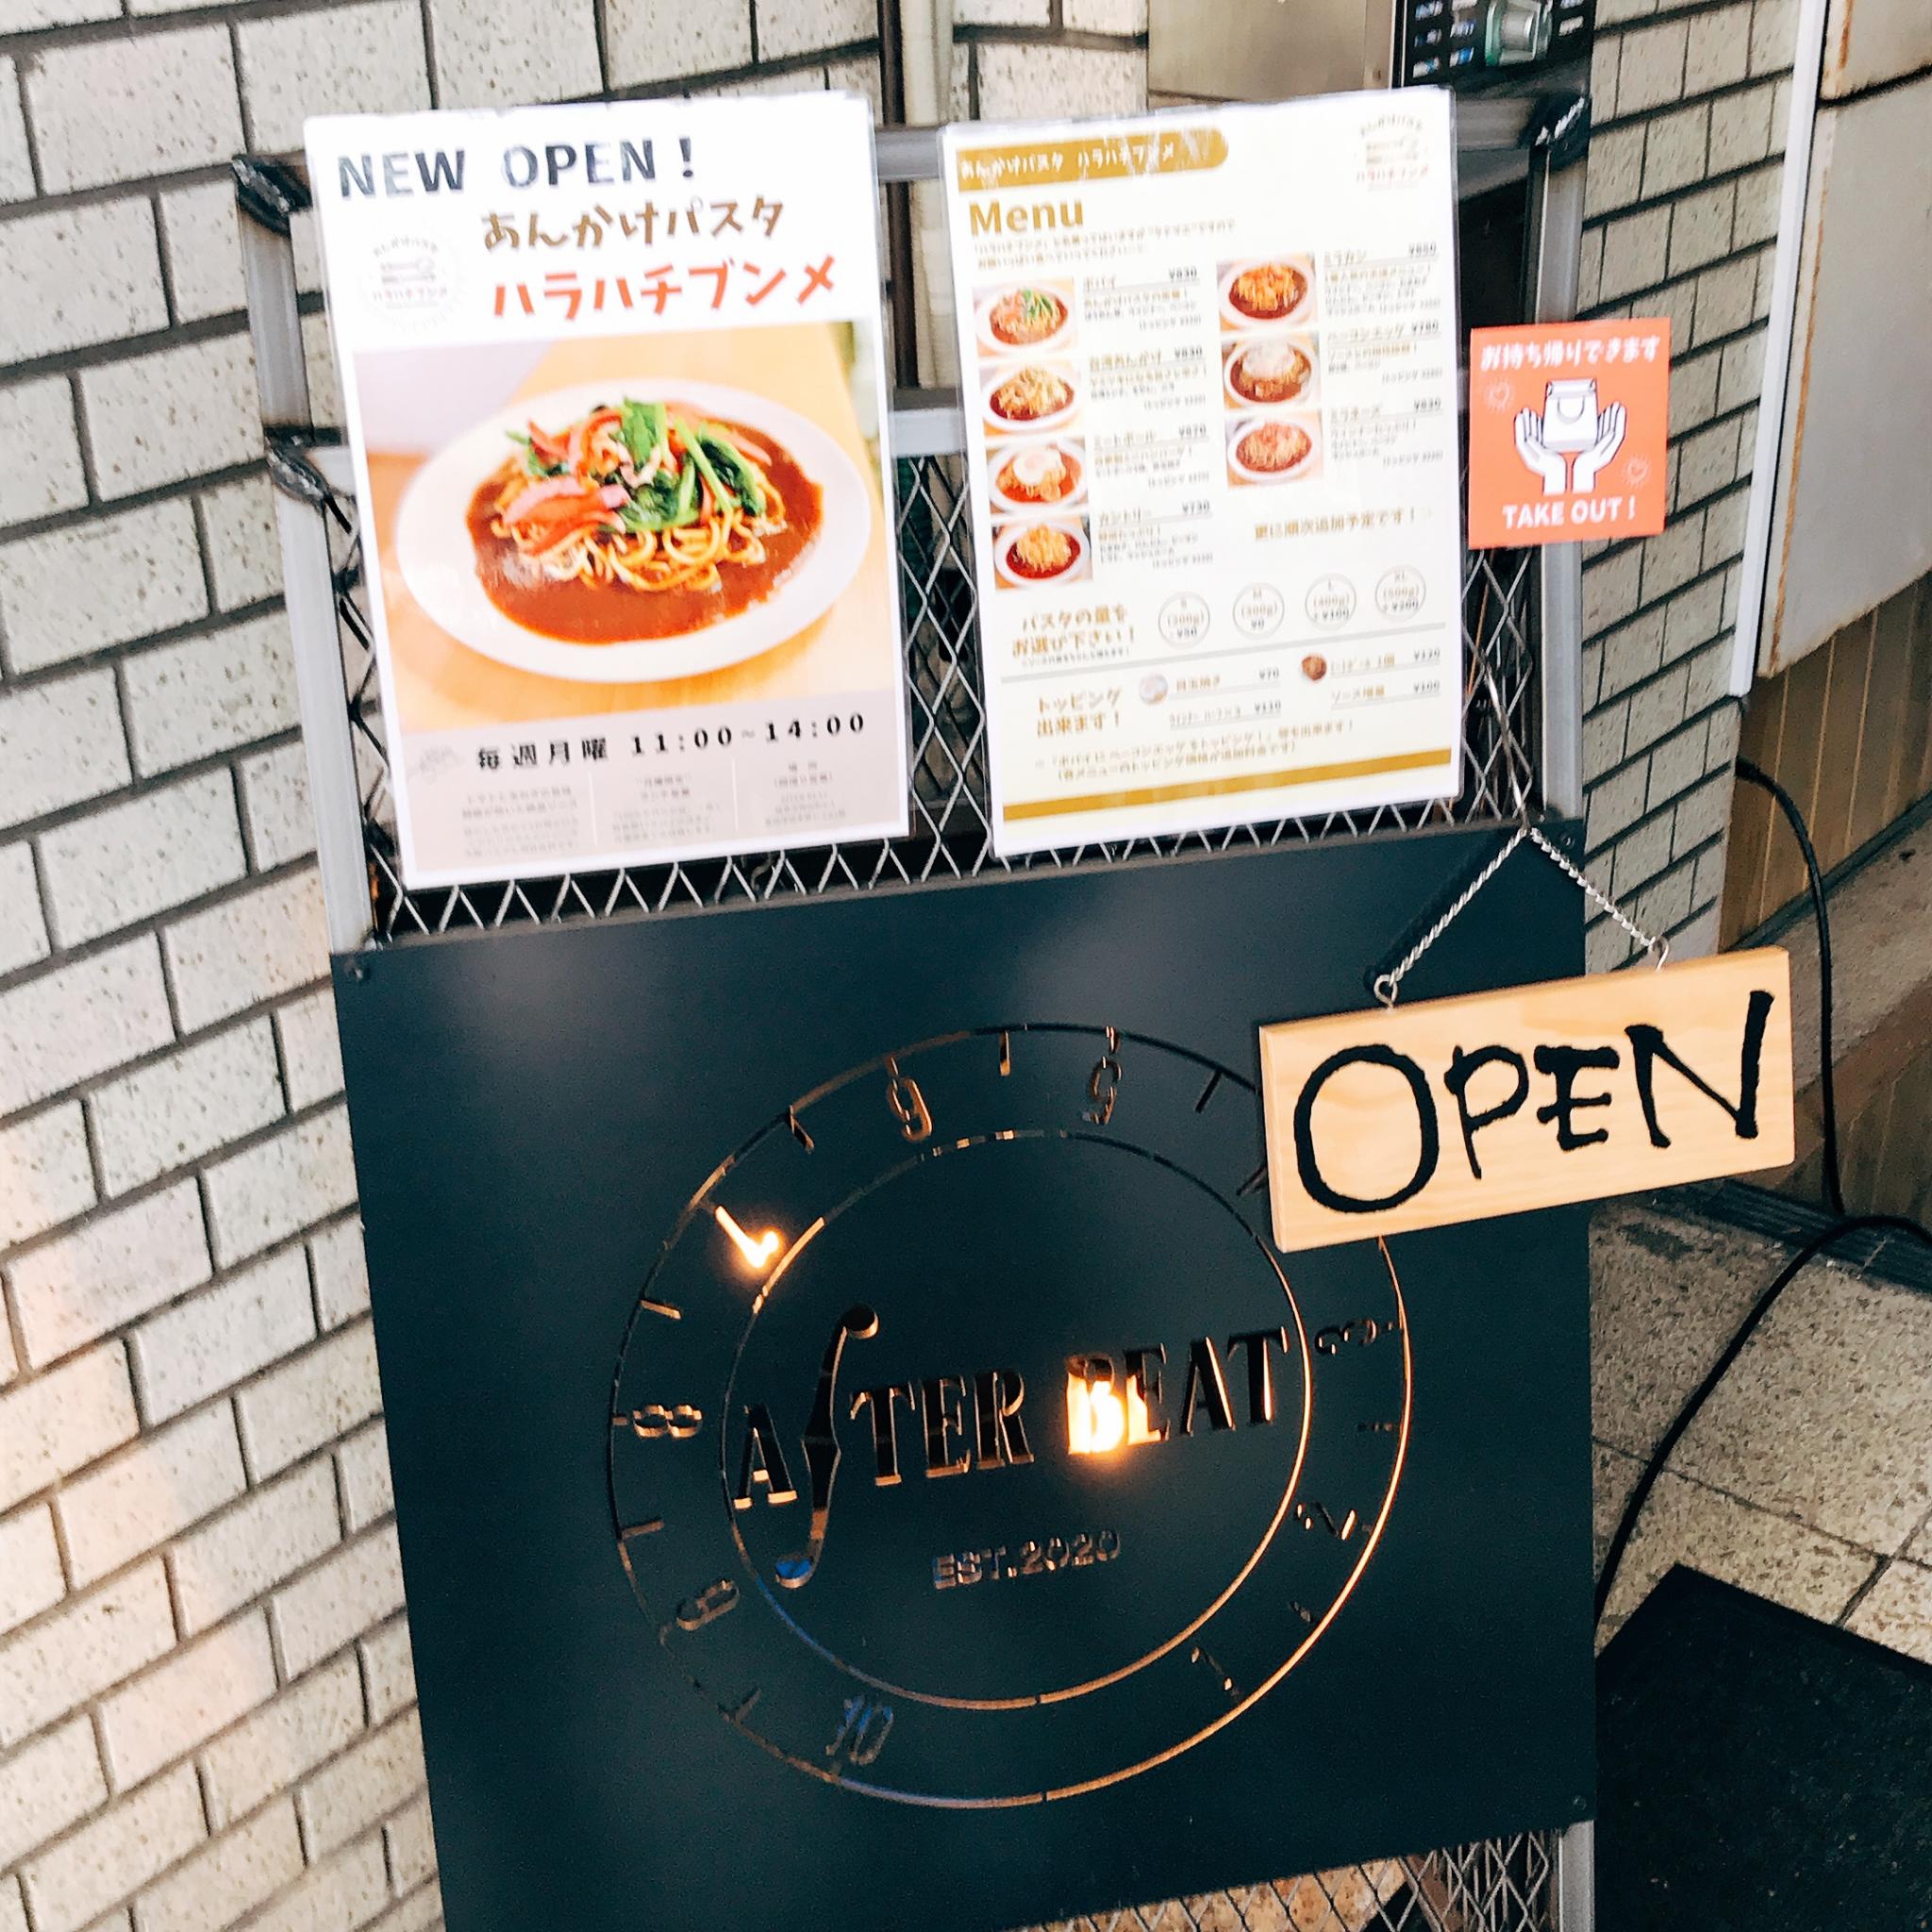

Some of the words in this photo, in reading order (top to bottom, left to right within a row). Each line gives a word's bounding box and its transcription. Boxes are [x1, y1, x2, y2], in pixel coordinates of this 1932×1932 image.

[338, 148, 466, 198] NEW
[482, 195, 785, 252] あんかけパスタ
[969, 198, 1084, 237] Menu
[492, 255, 836, 321] ハラハチブンメ
[1480, 334, 1660, 372] お持ち帰りできます
[1502, 501, 1566, 530] TAKE
[477, 737, 608, 771] 毎週月曜
[1292, 990, 1775, 1214] OPEN
[1065, 1324, 1291, 1457] BEAT
